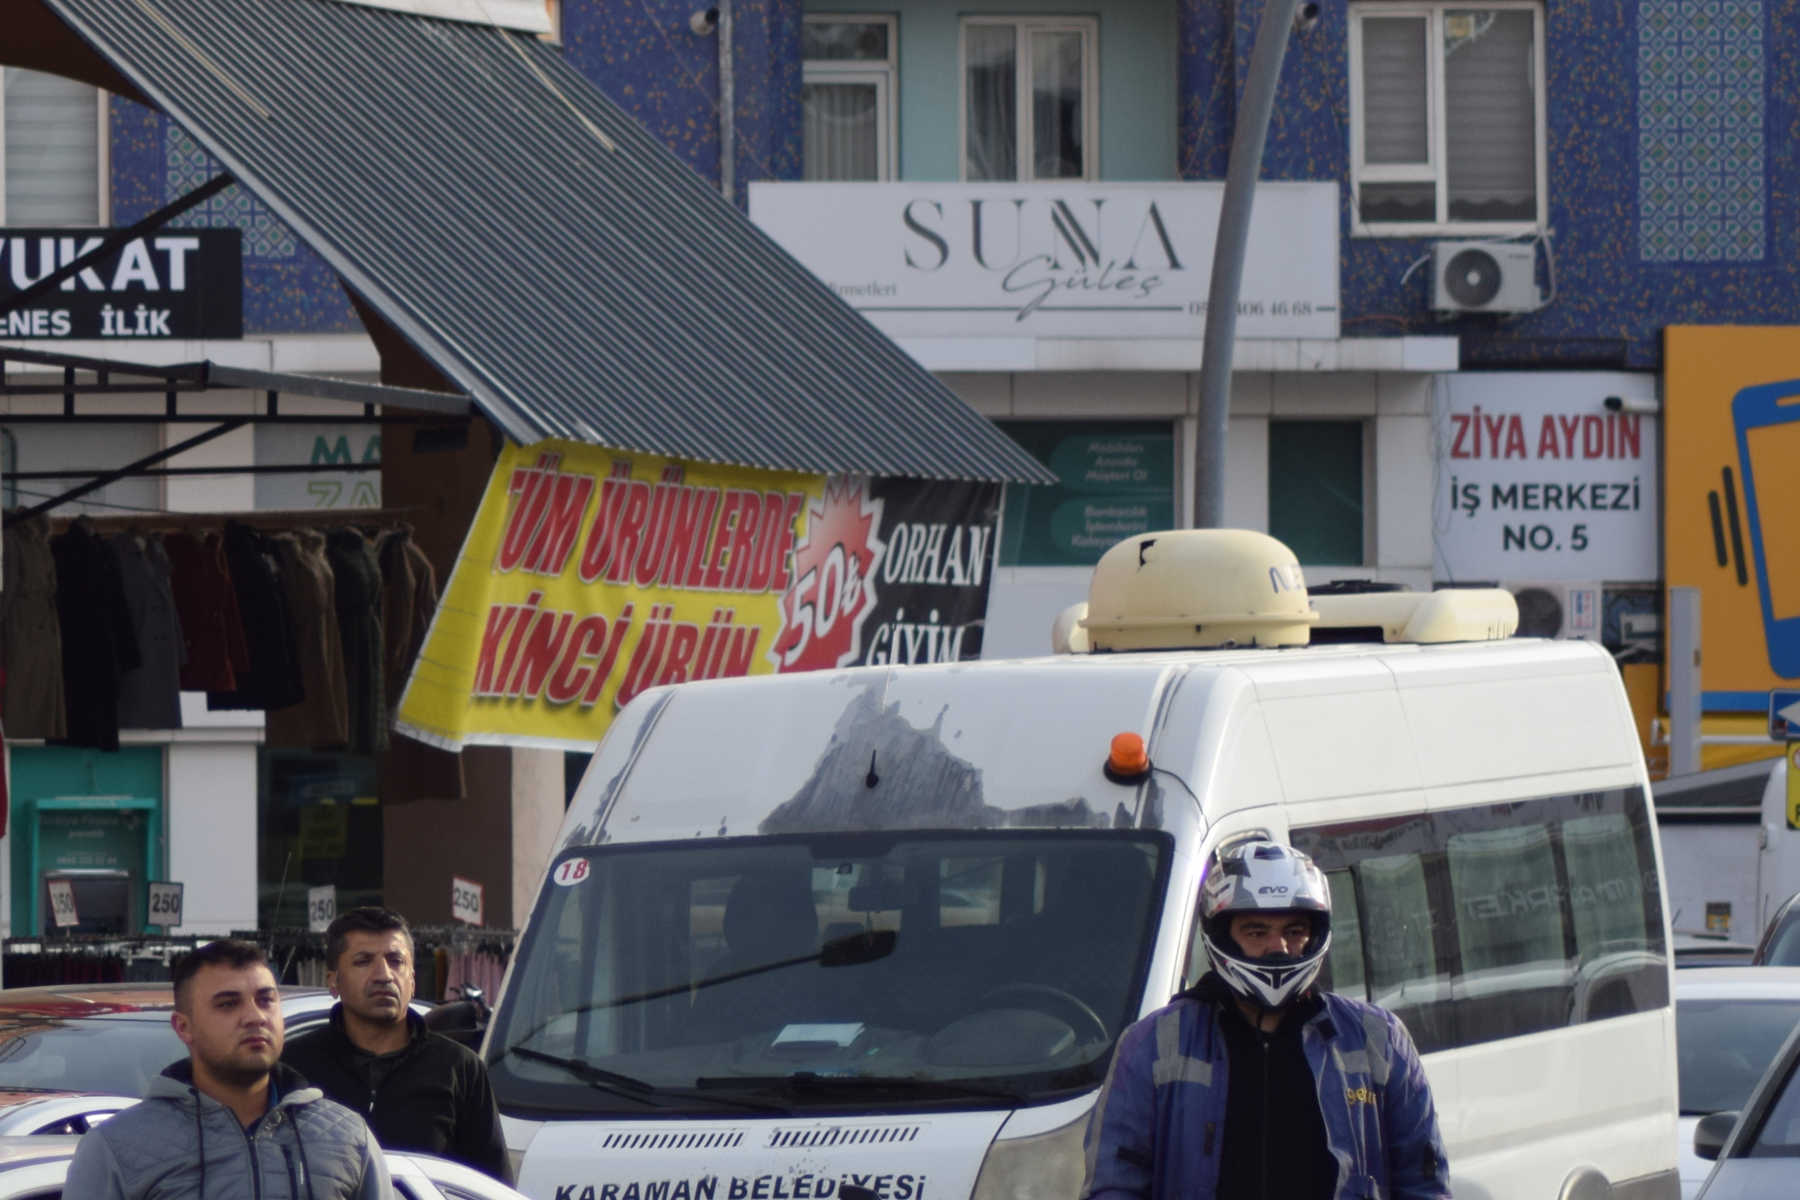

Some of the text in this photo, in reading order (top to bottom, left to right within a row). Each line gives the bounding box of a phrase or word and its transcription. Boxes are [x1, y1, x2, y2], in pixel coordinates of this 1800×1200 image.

[899, 197, 1188, 274] SUNA
[1000, 254, 1165, 323] Güleş
[100, 303, 172, 337] İLİK
[1449, 404, 1641, 461] ZİYA AYDIN
[1450, 475, 1641, 518] İŞ MERKEZİ
[578, 461, 805, 594] ÜRÜNLERDE
[1502, 524, 1590, 552] NO. 5
[882, 522, 992, 586] ORHAN
[616, 603, 761, 706] ÜRÜN
[864, 608, 965, 666] GİYİM
[558, 858, 590, 882] 18
[151, 893, 180, 914] 250
[310, 898, 334, 921] 250
[454, 886, 480, 913] 250
